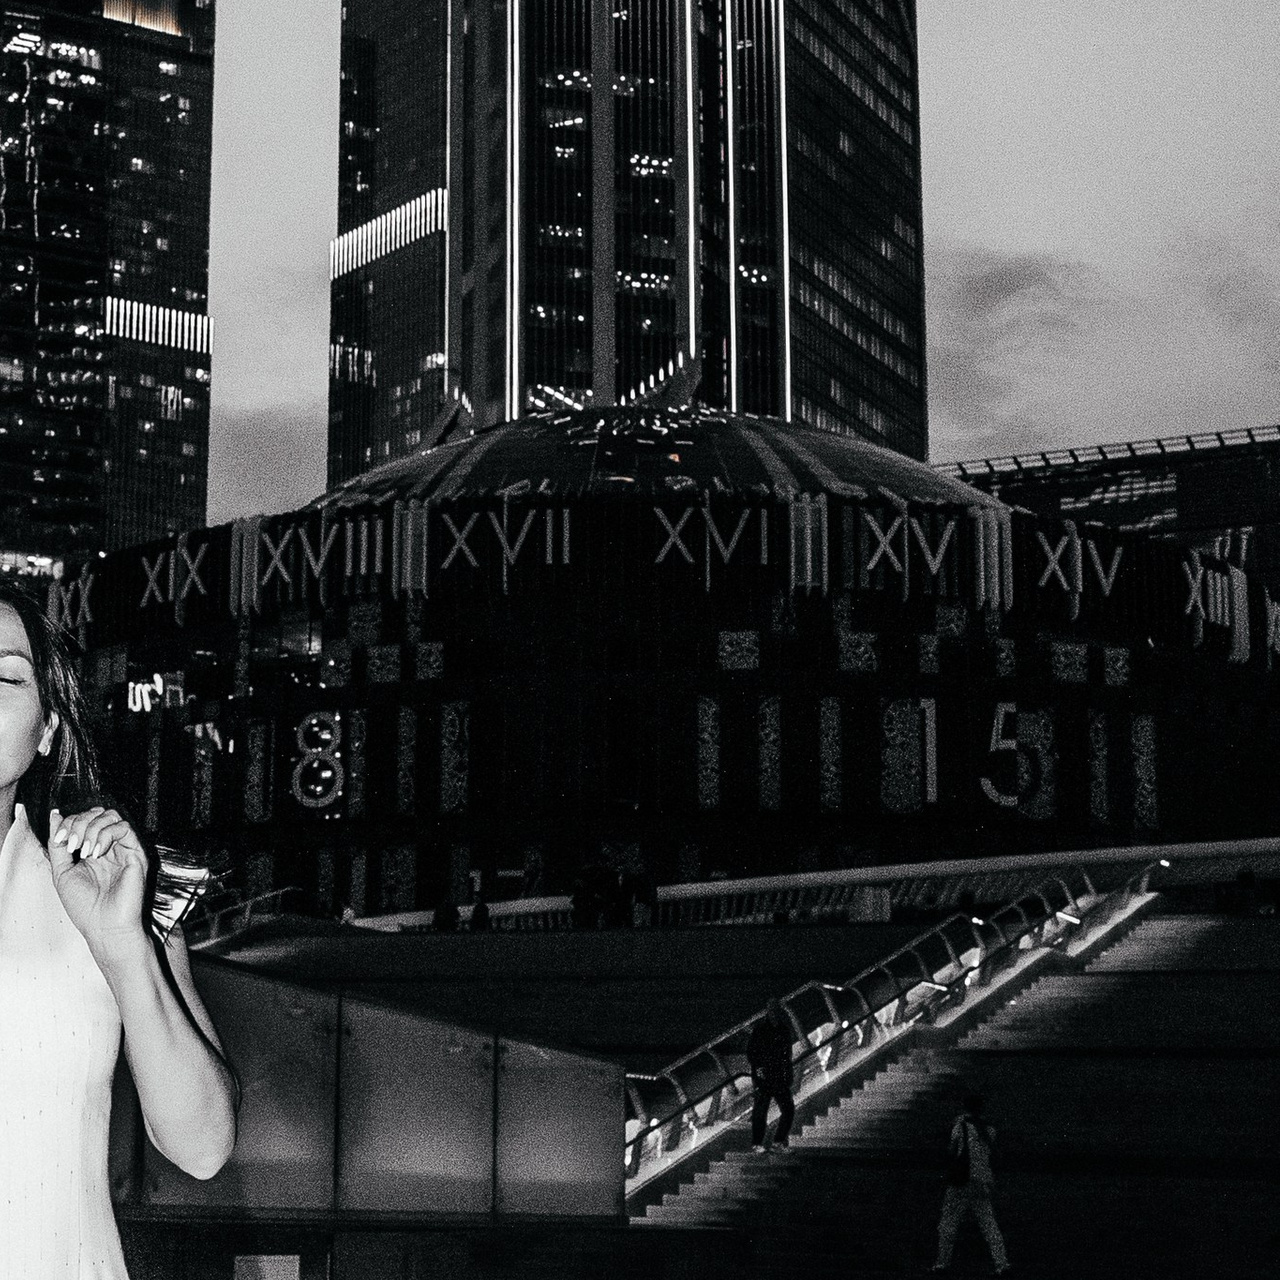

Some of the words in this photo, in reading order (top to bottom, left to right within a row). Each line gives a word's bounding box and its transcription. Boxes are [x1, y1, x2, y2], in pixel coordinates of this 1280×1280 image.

[260, 517, 384, 586] XVIII
[440, 508, 571, 569] XVII
[653, 506, 769, 566] XVI
[863, 512, 957, 575] XV
[1036, 531, 1124, 597] XIV
[139, 542, 210, 609] XIX
